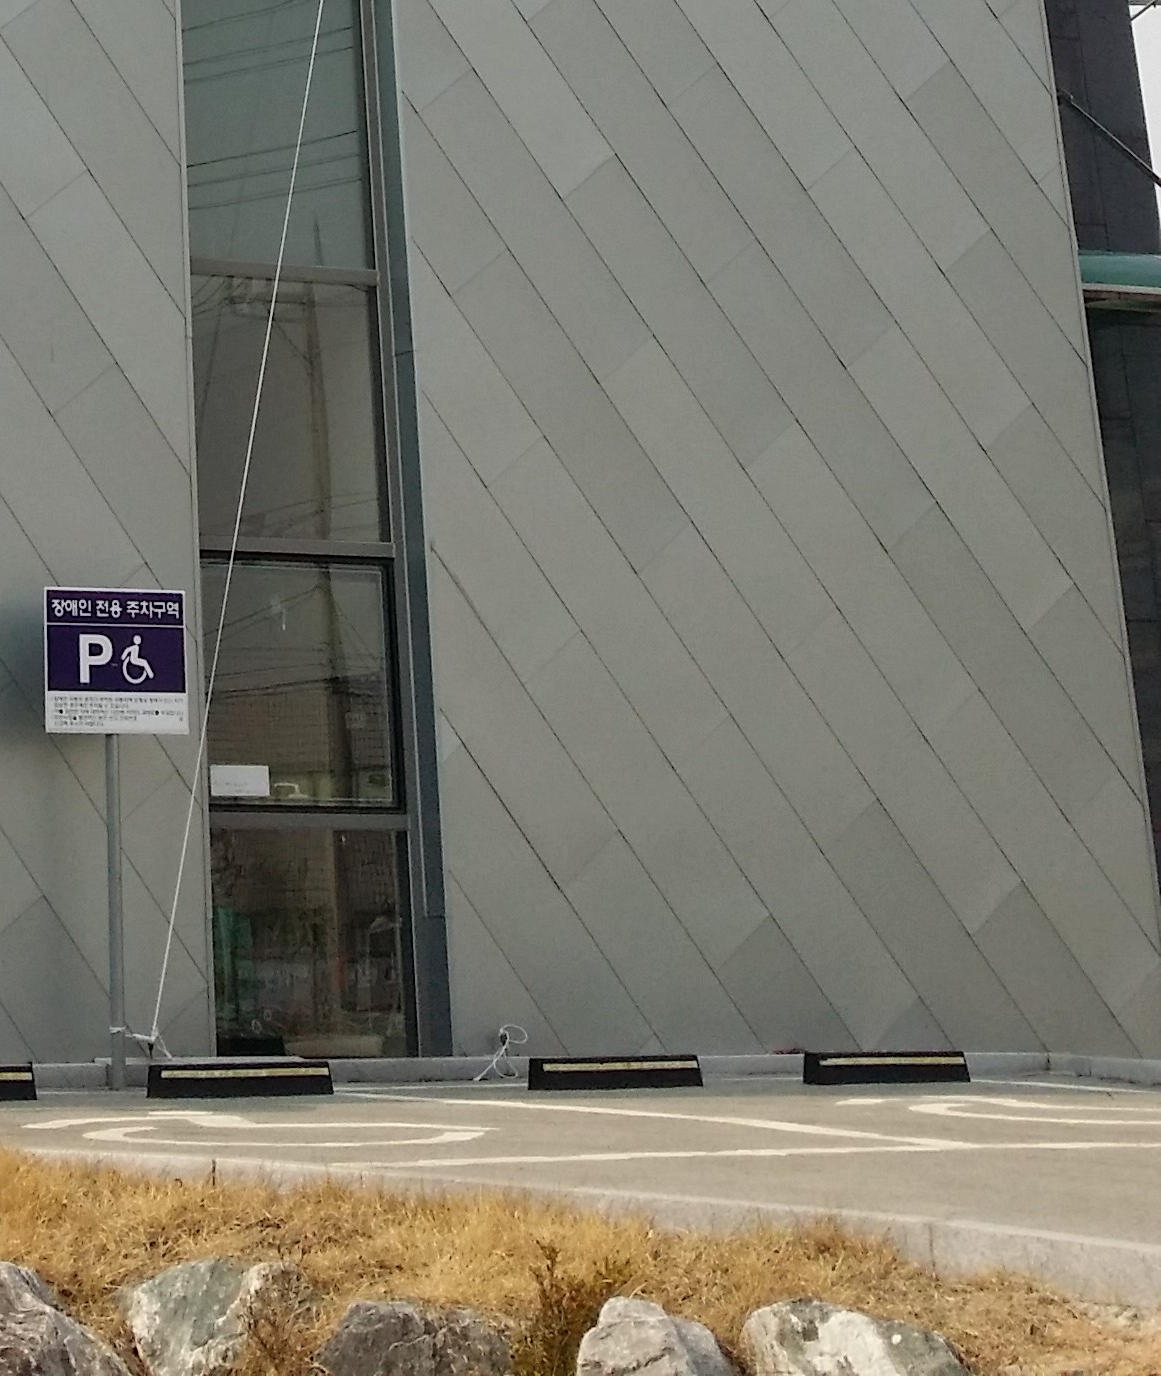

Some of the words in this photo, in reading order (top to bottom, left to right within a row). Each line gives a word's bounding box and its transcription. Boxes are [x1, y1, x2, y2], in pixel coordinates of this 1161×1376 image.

[51, 599, 92, 617] 장애인
[96, 599, 123, 618] 전용
[126, 601, 180, 619] 주차구역
[78, 633, 114, 684] P
